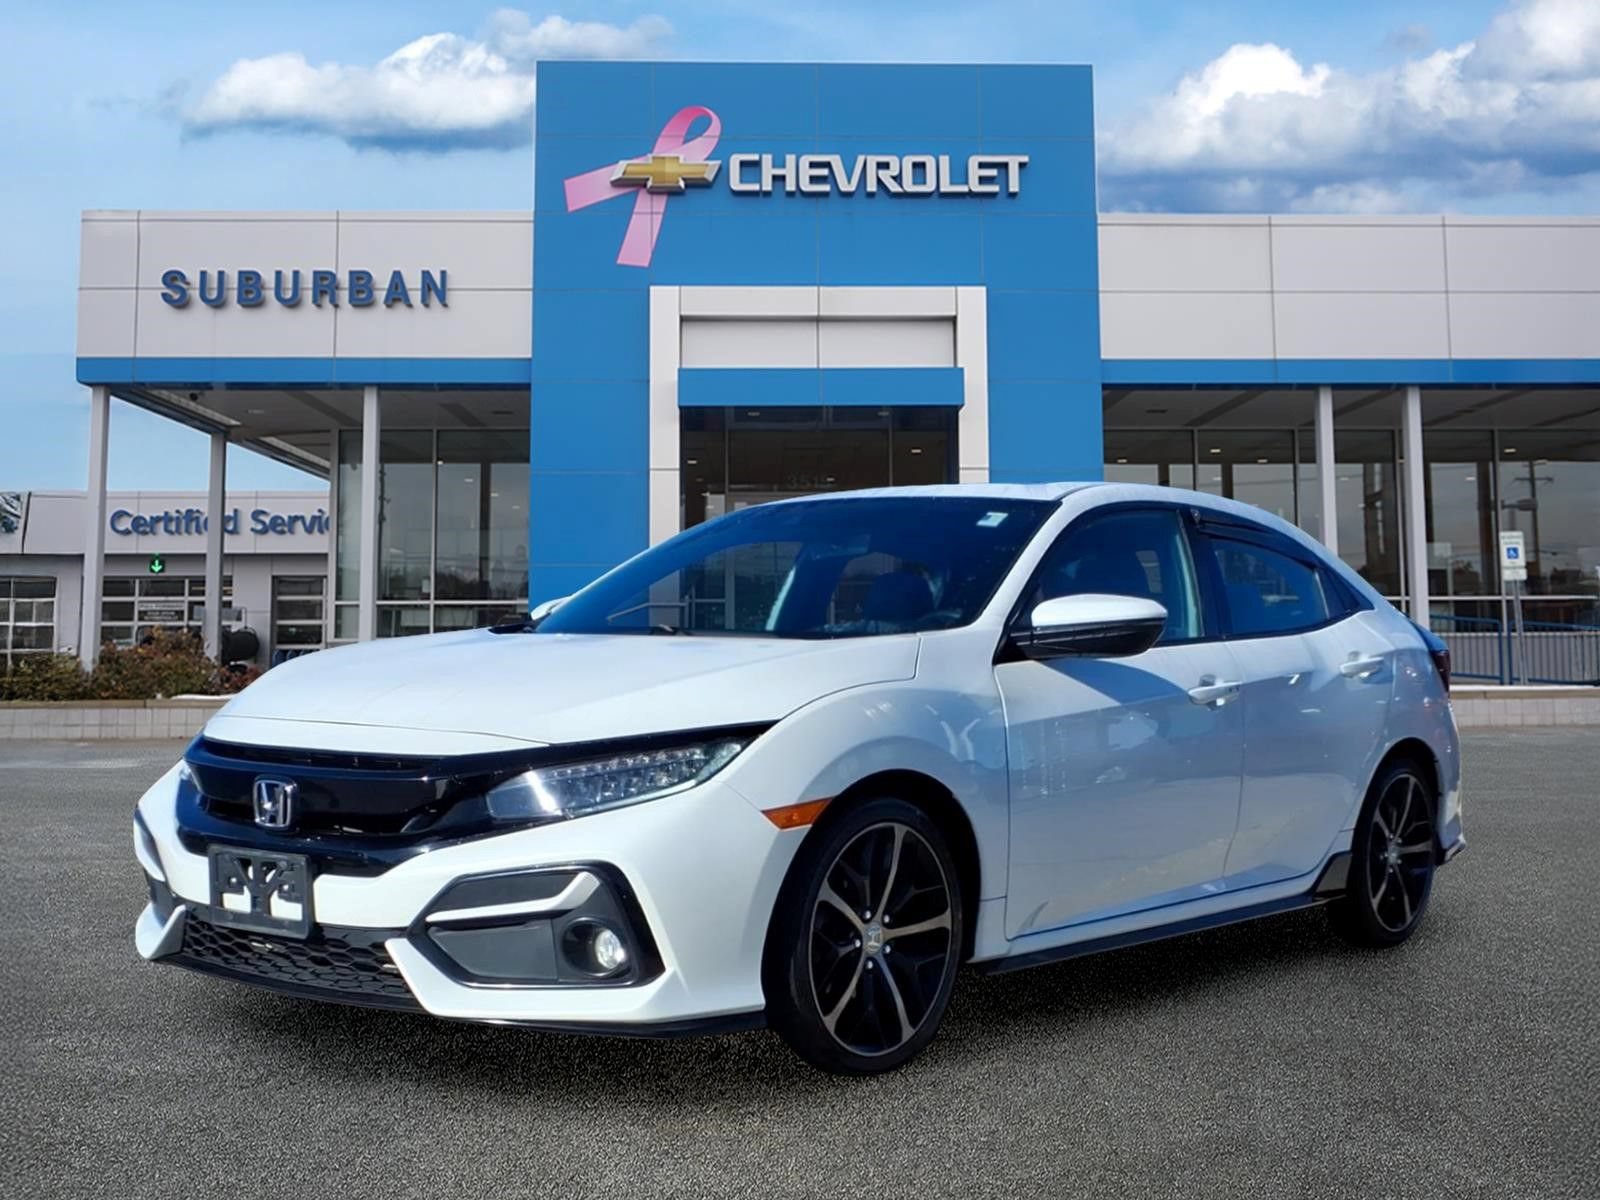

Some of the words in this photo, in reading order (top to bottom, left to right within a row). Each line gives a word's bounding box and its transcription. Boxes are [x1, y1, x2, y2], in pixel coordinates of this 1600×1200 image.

[729, 154, 1029, 193] CHEVROLET
[161, 269, 449, 308] SUBURBAN
[109, 508, 240, 535] Certifid
